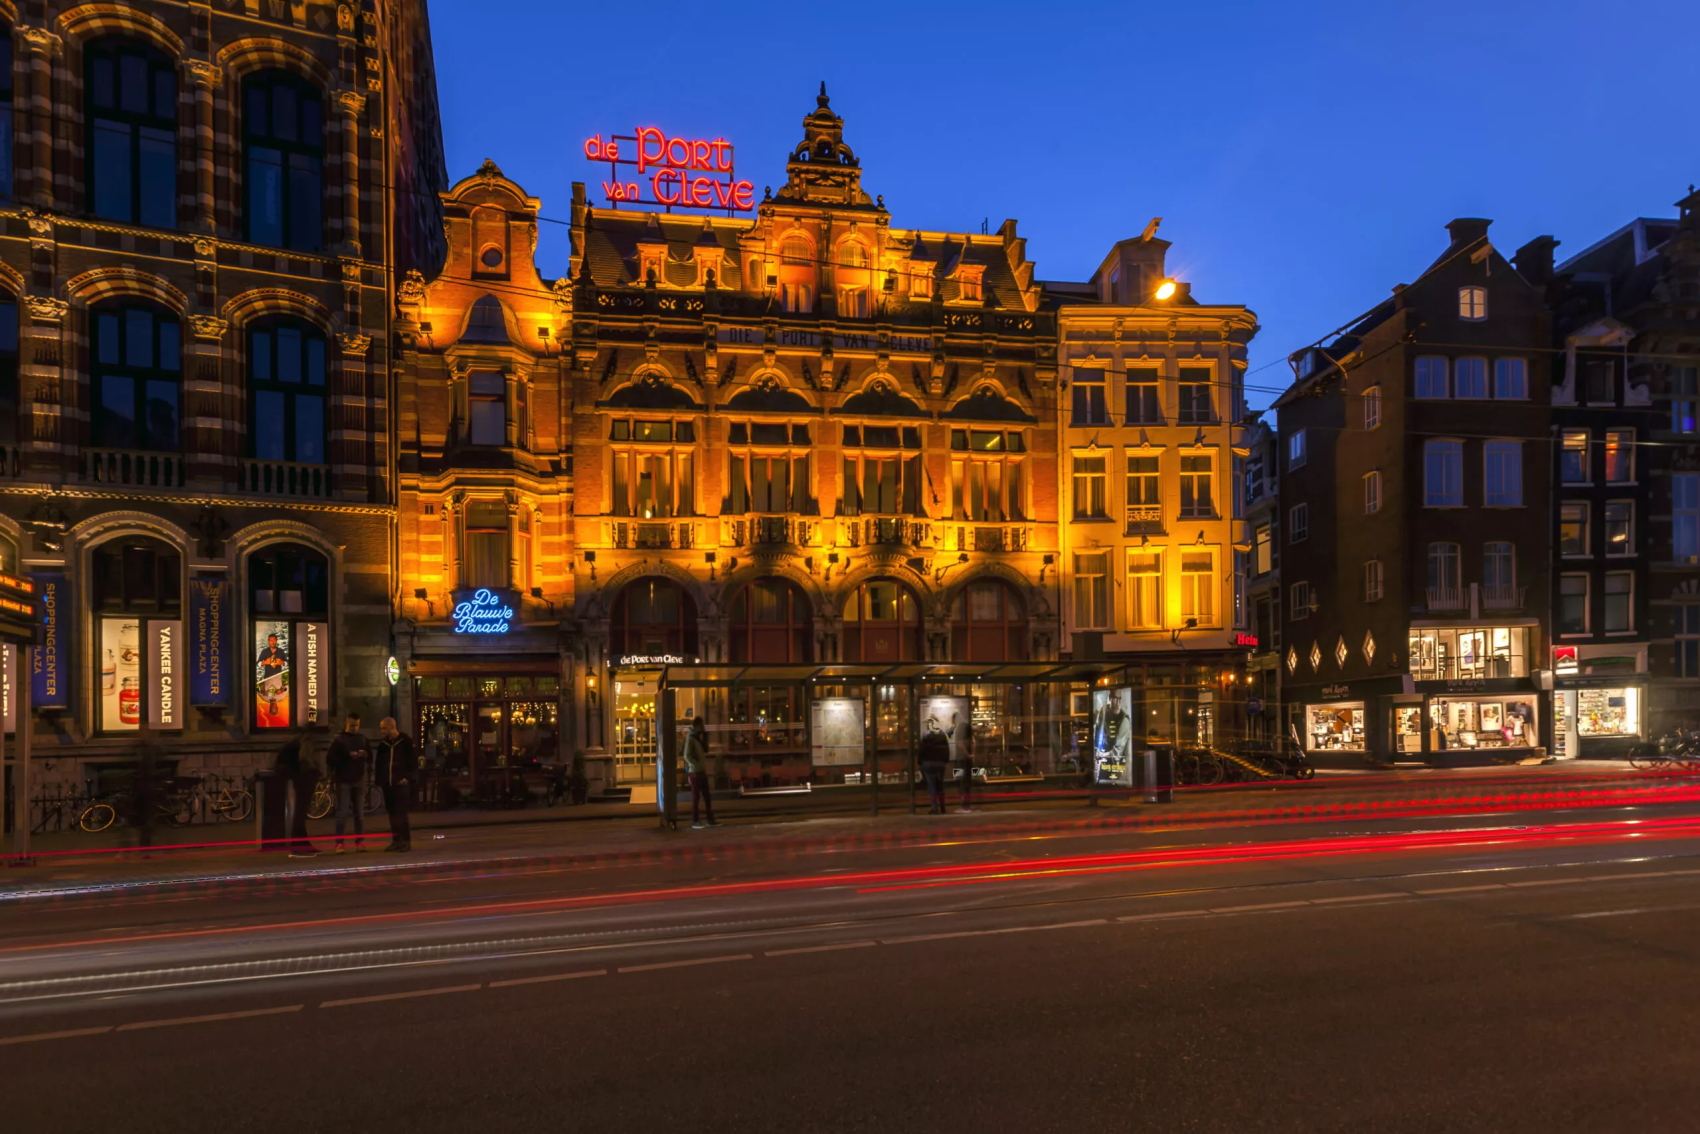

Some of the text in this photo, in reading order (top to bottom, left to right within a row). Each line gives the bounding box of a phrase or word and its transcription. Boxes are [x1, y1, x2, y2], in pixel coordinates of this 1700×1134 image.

[585, 134, 619, 161] die
[603, 182, 639, 201] van
[729, 327, 930, 351] DIE PORT VAN CLEVE
[472, 589, 499, 605] De
[453, 602, 513, 619] Blauwe
[307, 623, 317, 632] A
[455, 616, 509, 633] Parade
[46, 582, 56, 697] SHOPPINGCENTER
[210, 588, 220, 695] SHOPPINGCENTER
[307, 633, 317, 657] FISH
[199, 644, 207, 674] PLAZA
[650, 655, 663, 663] van
[160, 627, 172, 723] YANKEE CANDLE
[307, 659, 317, 697] NAMED
